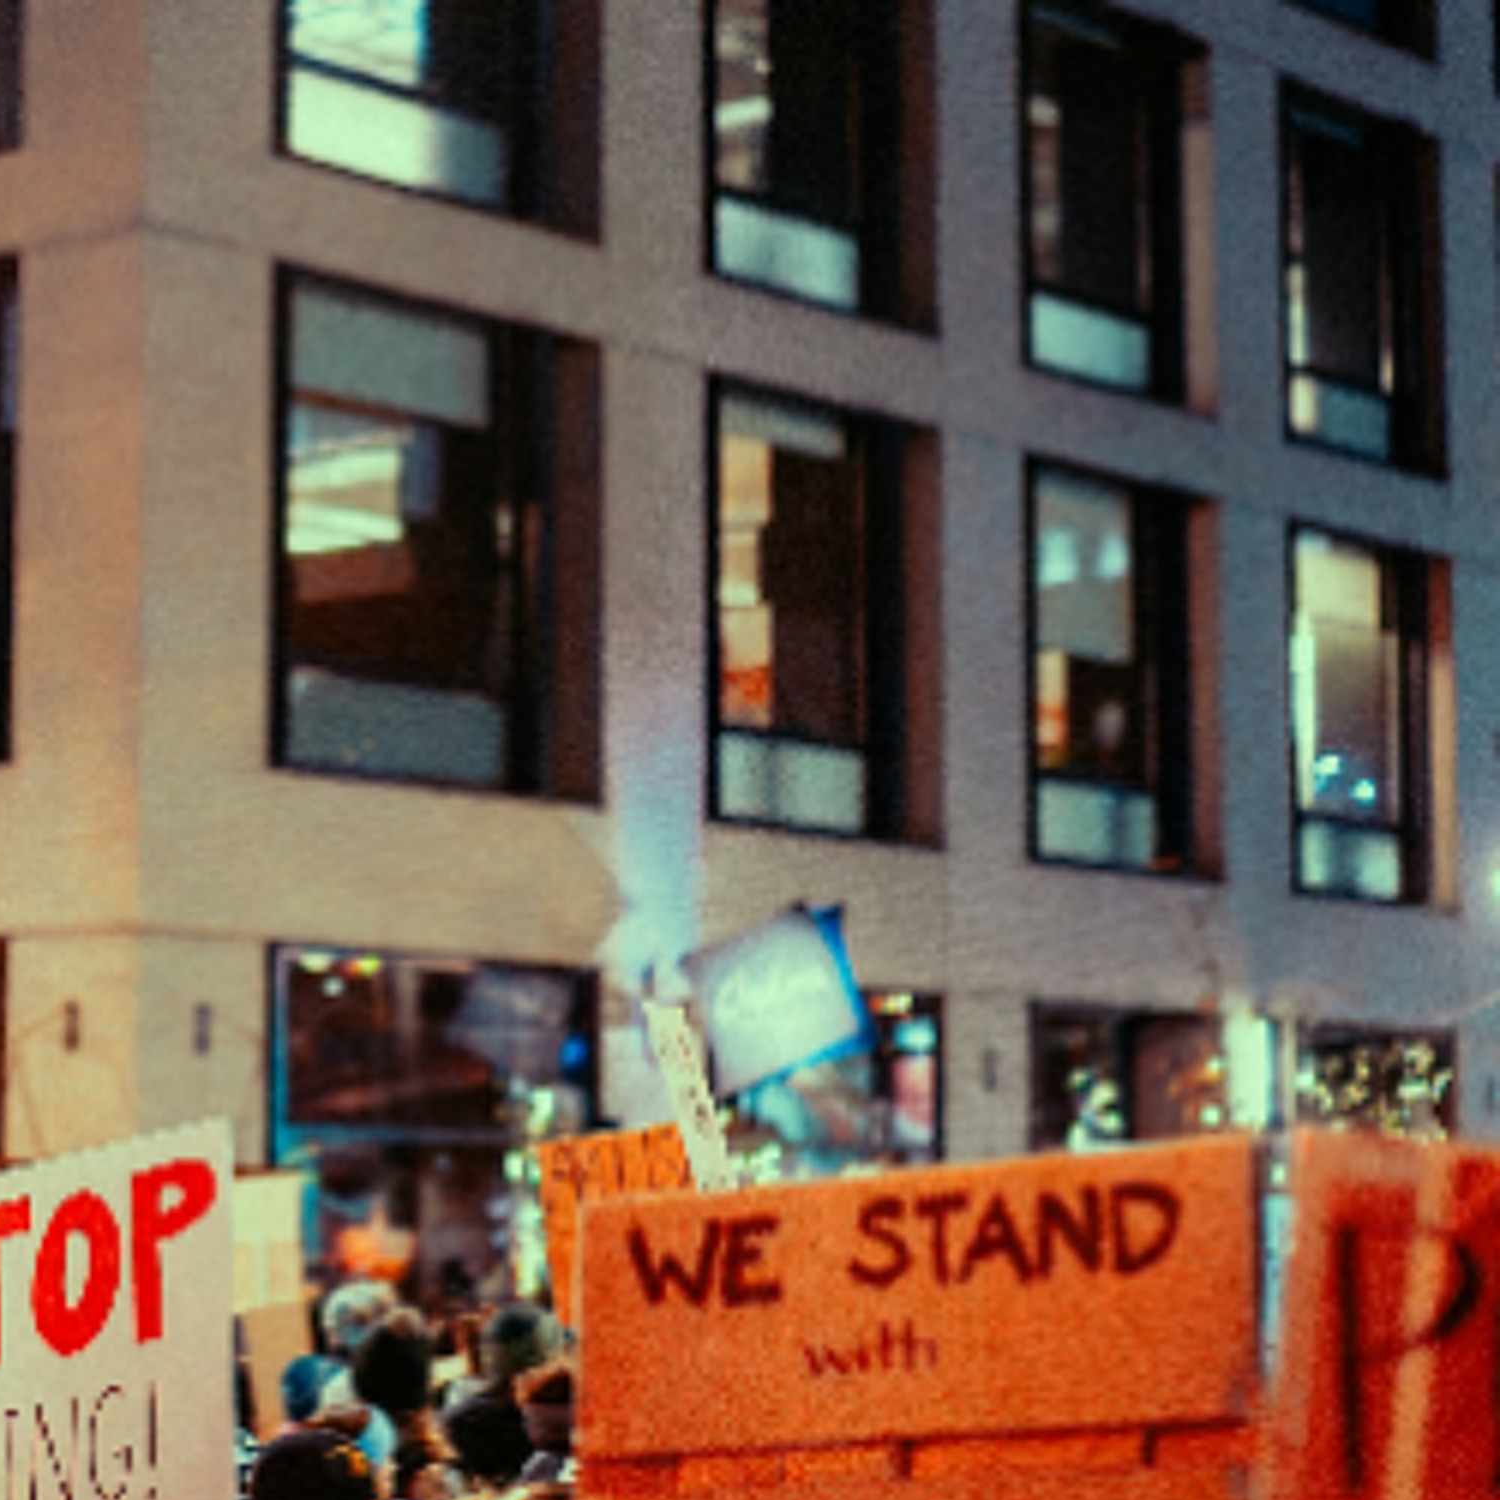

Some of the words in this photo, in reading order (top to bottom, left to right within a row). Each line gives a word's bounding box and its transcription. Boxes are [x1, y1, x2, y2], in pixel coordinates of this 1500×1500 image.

[626, 1215, 784, 1310] WE
[847, 1181, 1183, 1289] STAND
[803, 1318, 938, 1376] with
